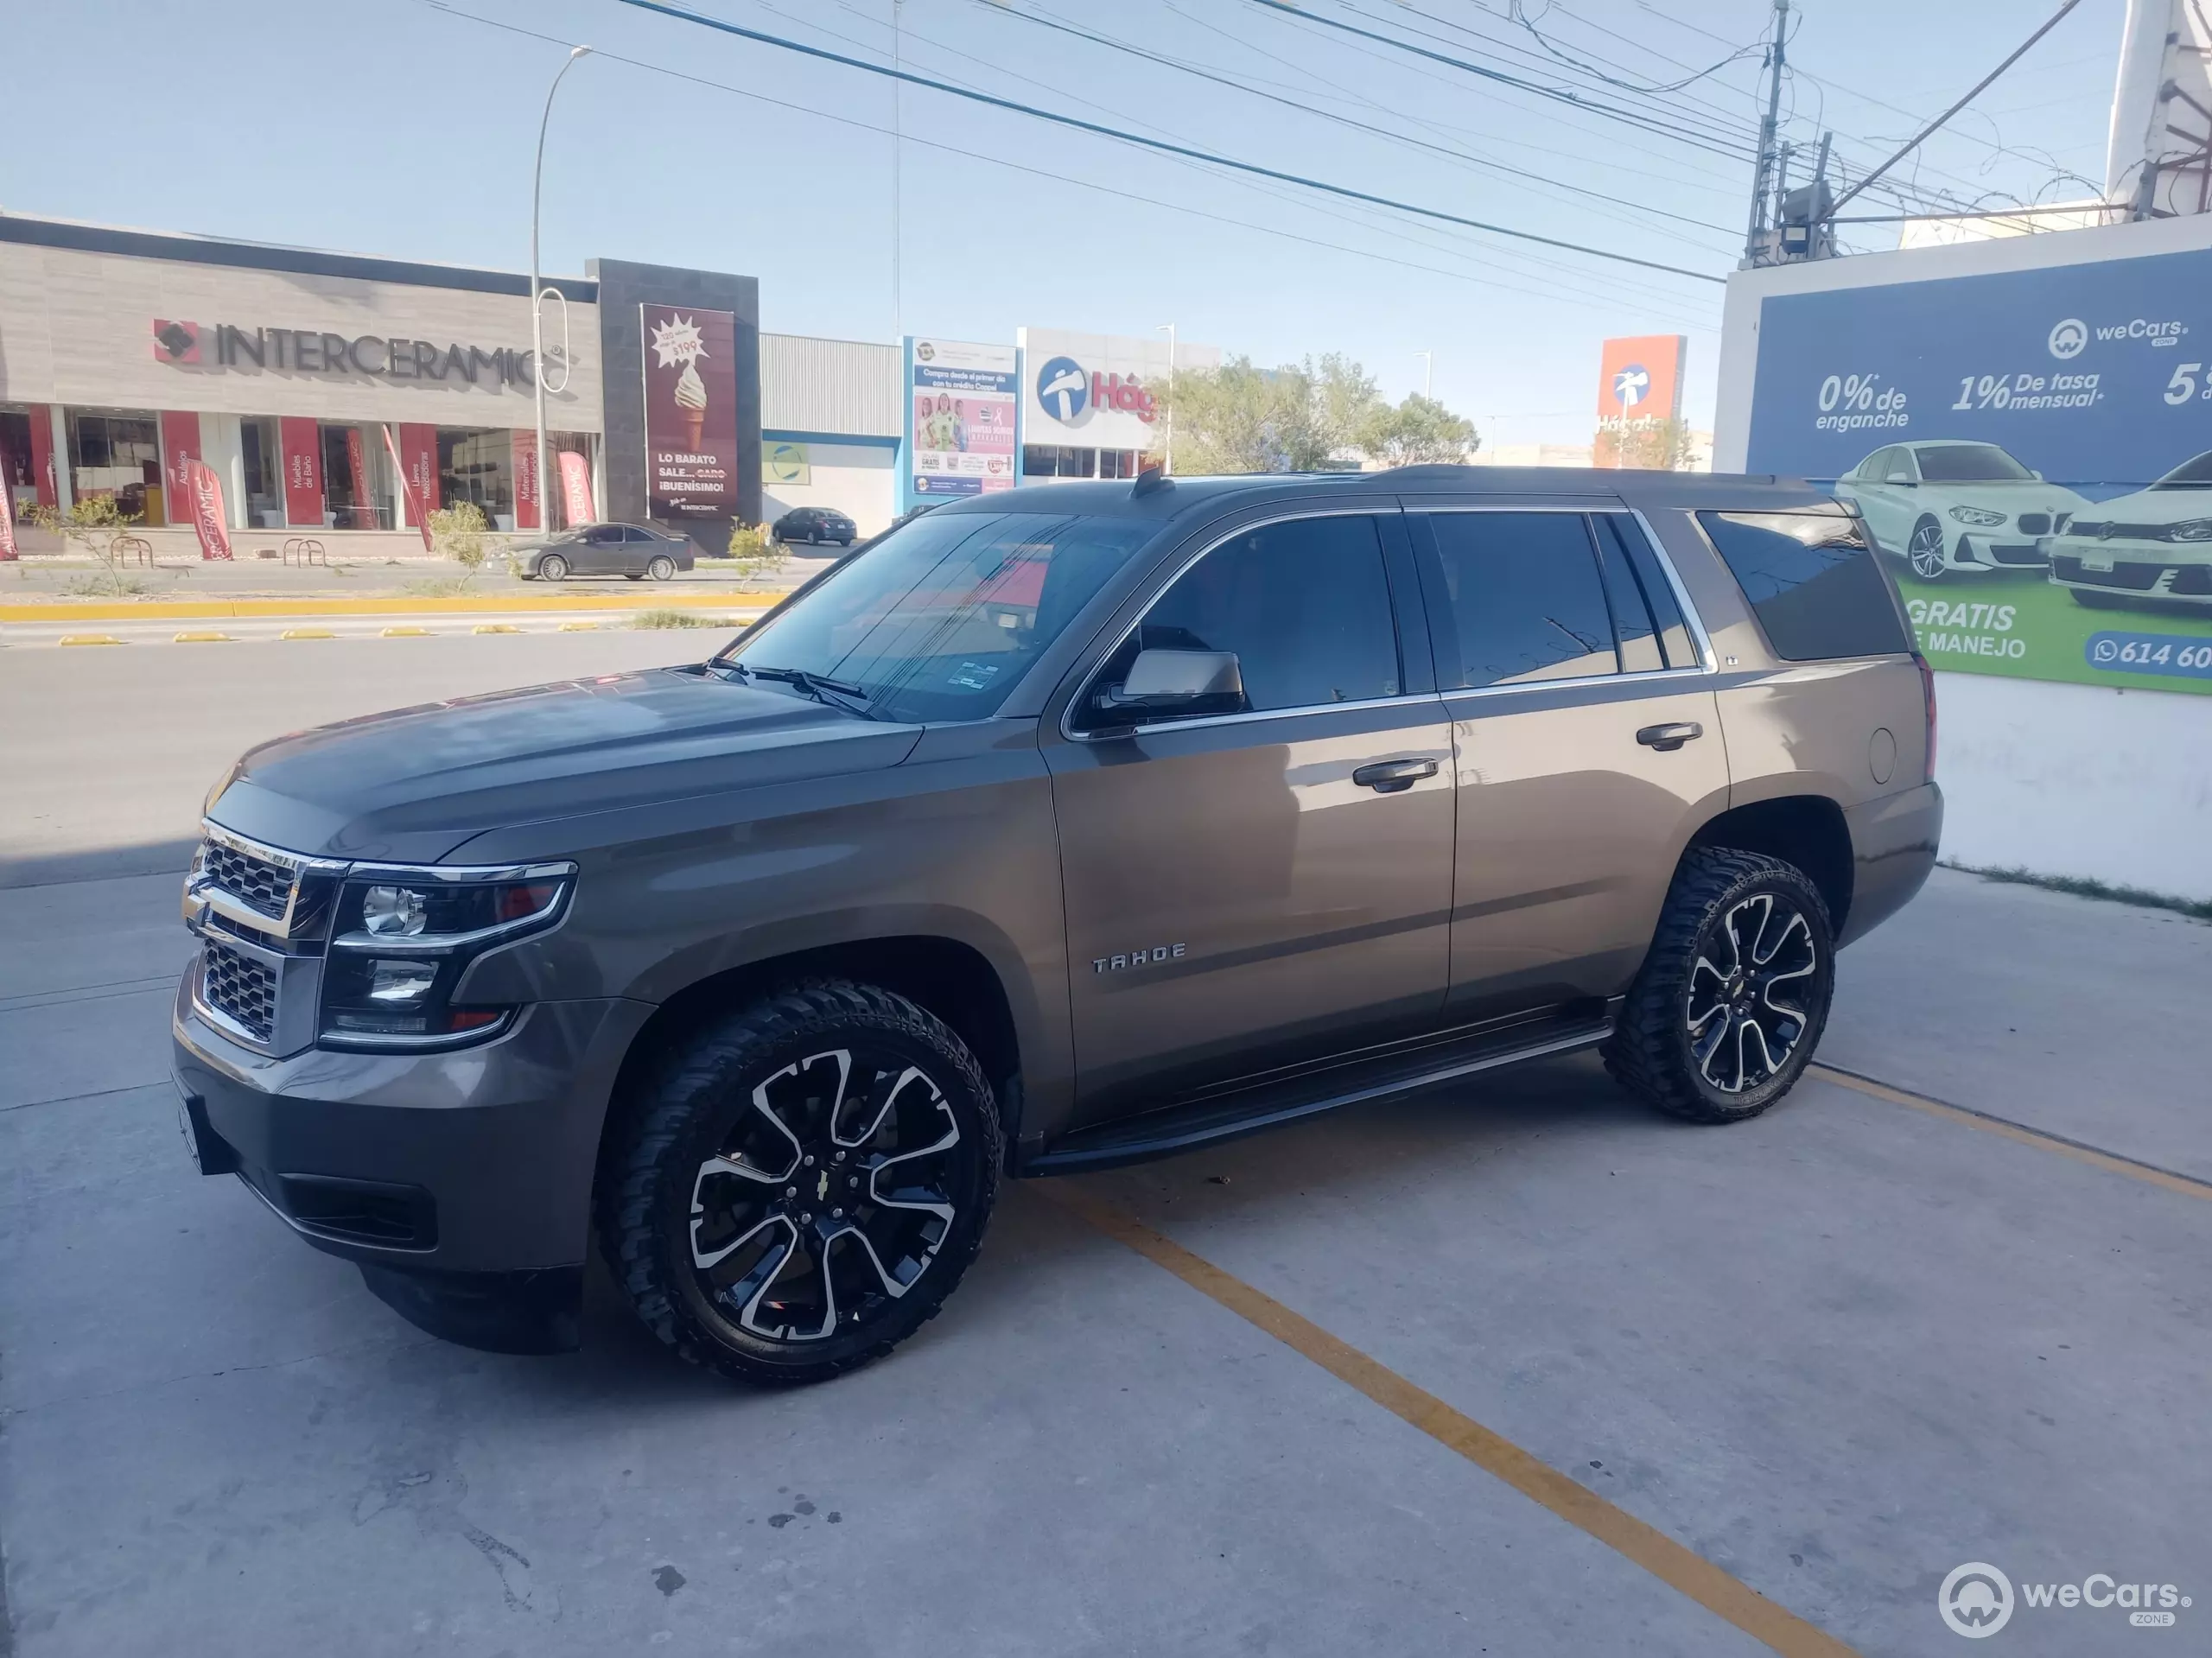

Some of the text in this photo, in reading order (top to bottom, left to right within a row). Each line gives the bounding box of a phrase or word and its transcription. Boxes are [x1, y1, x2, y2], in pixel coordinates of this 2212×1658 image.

[923, 368, 949, 378] Compra
[950, 370, 969, 379] desde
[976, 373, 995, 383] primer
[2014, 372, 2101, 391] De tasa
[2164, 363, 2202, 405] 5
[1876, 387, 1907, 411] de
[1952, 374, 2012, 410] 1%
[1815, 410, 1910, 433] enganche
[179, 450, 188, 485] Azulejos
[293, 454, 302, 489] Muebles
[303, 455, 313, 488] de Baño
[658, 454, 716, 465] LO BARATO
[520, 456, 530, 500] Materiales
[531, 496, 539, 507] de
[1906, 599, 2017, 631] GRATIS
[1929, 633, 2026, 659] MANEJO
[2120, 642, 2212, 669] 614 60
[1092, 943, 1185, 974] TAHOE
